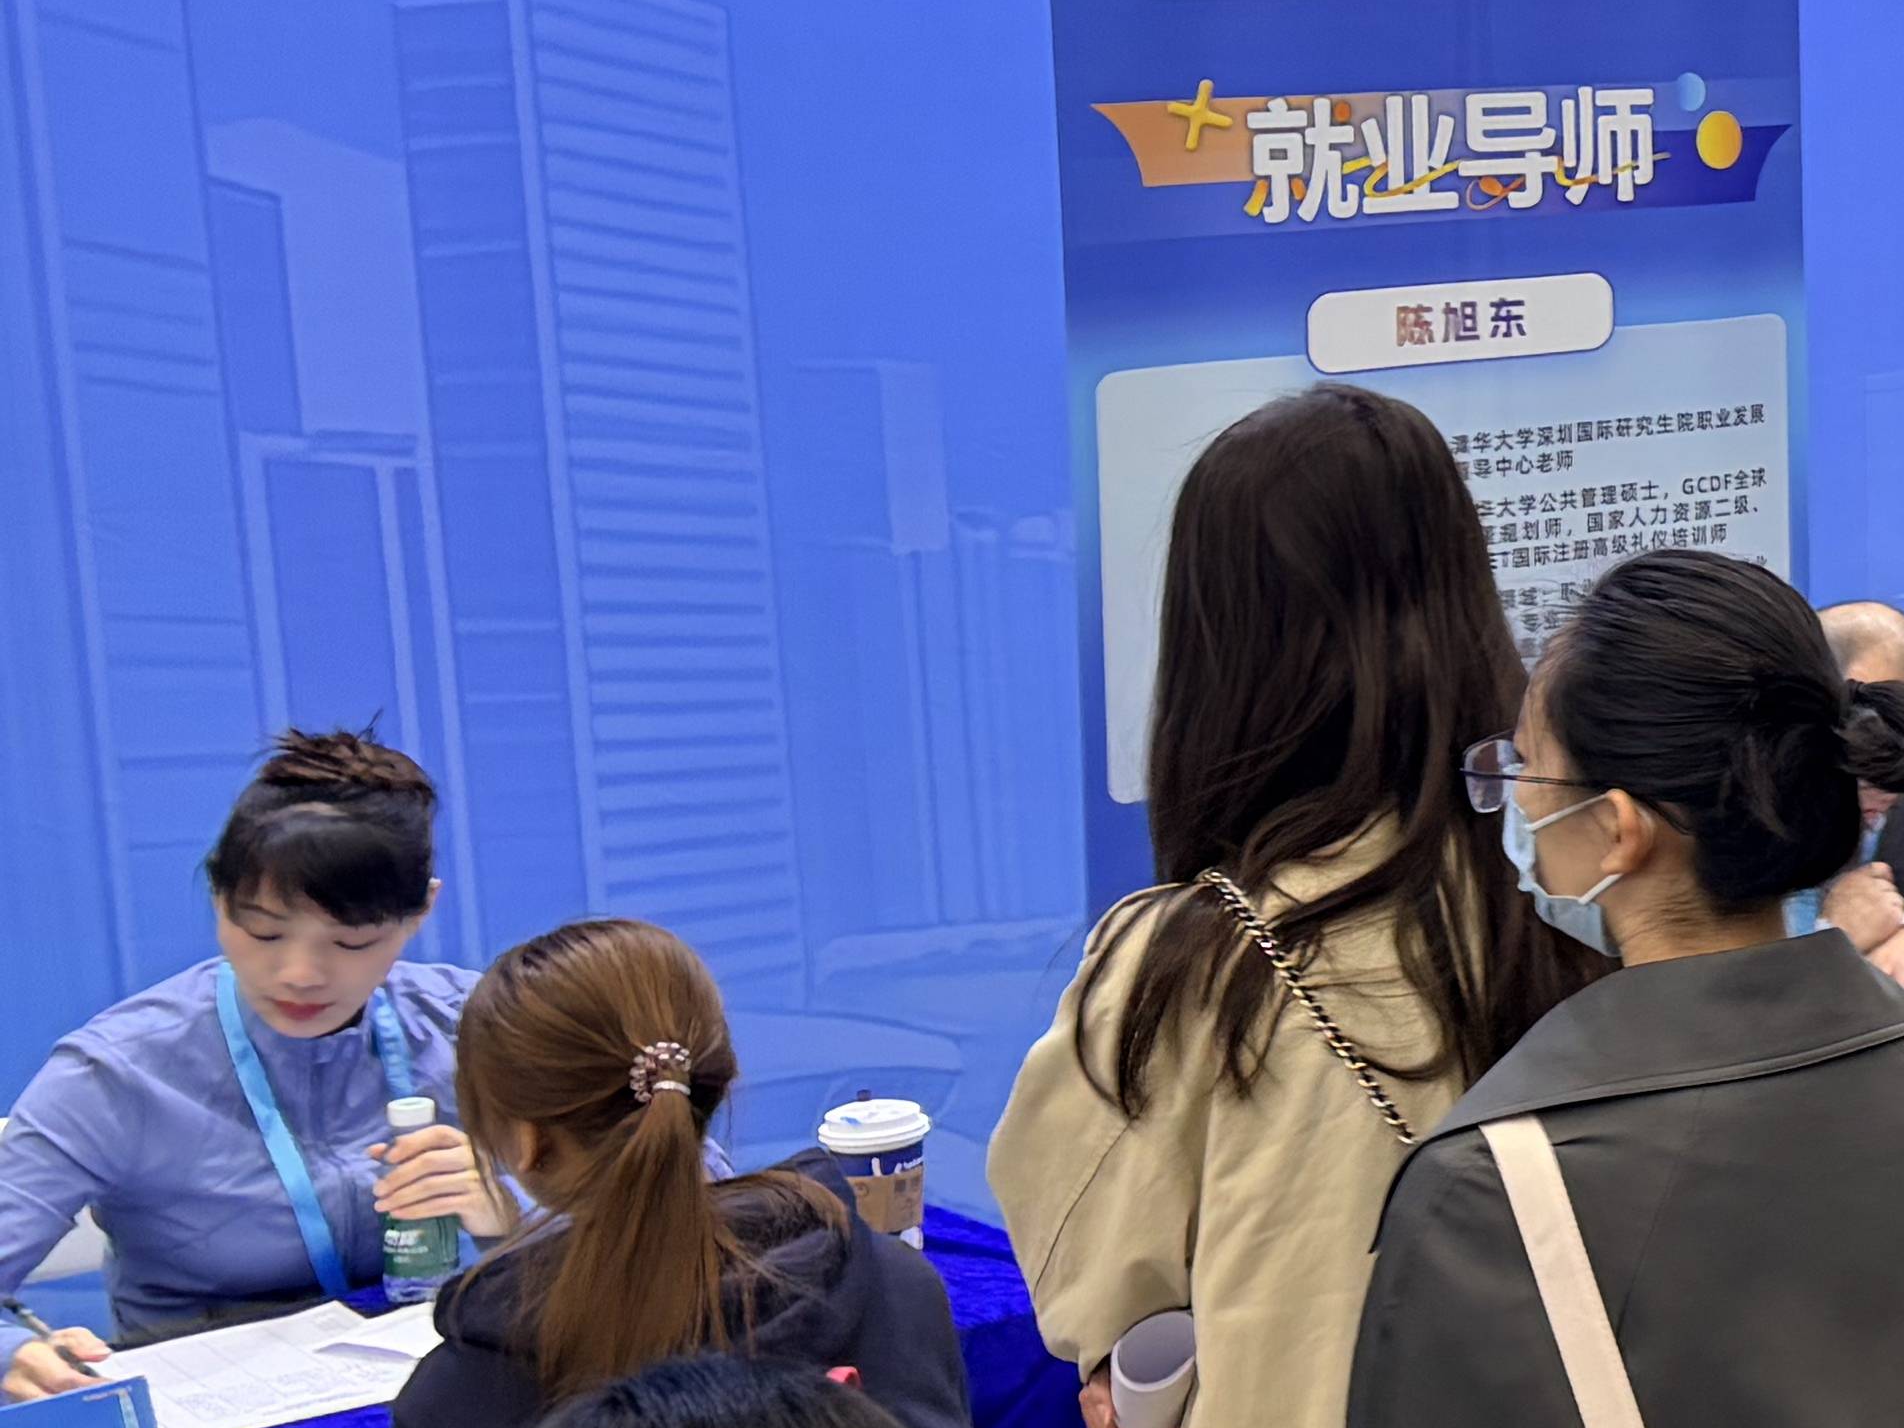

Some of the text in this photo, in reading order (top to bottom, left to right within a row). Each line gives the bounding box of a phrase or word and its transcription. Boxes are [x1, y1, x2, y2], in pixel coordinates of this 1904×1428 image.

[1243, 85, 1656, 224] 就业导师
[1396, 297, 1527, 347] 陈旭东
